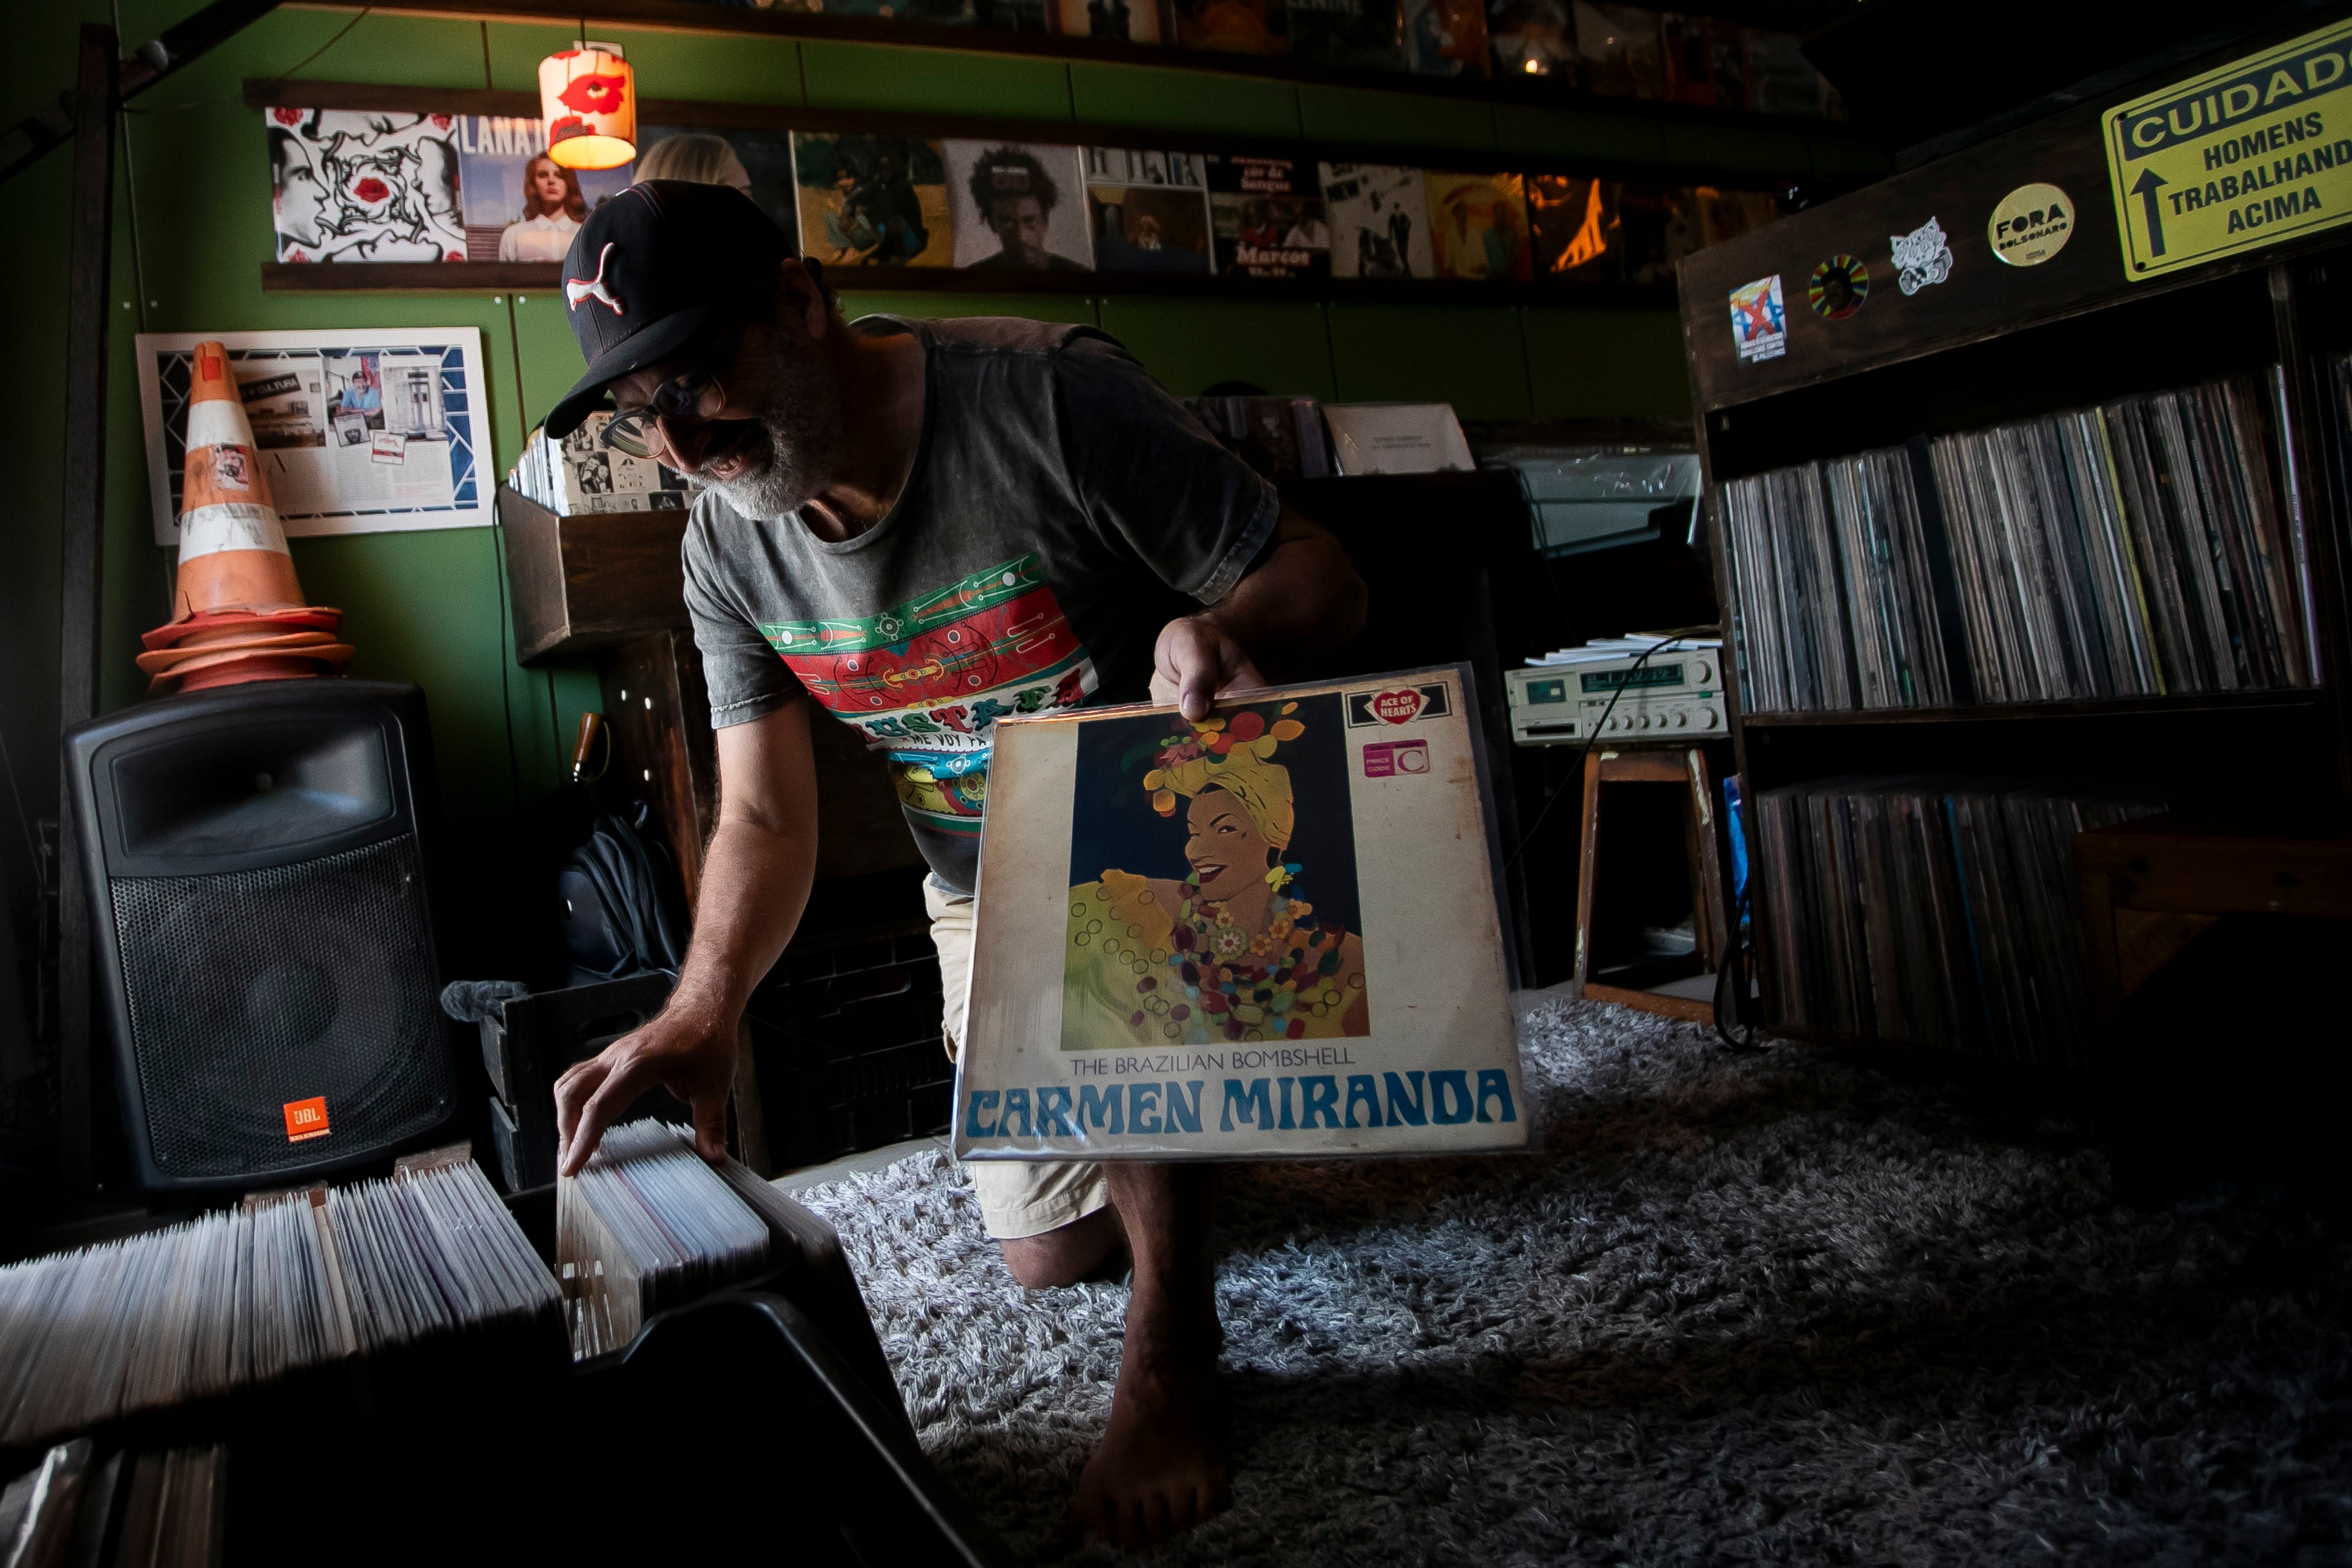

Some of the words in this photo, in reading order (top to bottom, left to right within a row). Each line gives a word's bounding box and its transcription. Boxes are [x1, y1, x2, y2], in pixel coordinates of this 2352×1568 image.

[2132, 47, 2352, 148] CUIDAD
[460, 114, 532, 155] LANA
[2203, 111, 2324, 171] HOMENS
[2168, 139, 2352, 216] TRABALHAND
[1996, 203, 2066, 240] FORA
[2227, 186, 2322, 235] ACIMA
[1380, 703, 1416, 717] HEARTS
[1381, 698, 1399, 707] ACE
[1400, 695, 1414, 705] OF
[908, 734, 932, 745] ME
[934, 734, 961, 746] VOY
[1397, 750, 1425, 773] C
[1070, 1058, 1108, 1076] THE
[1115, 1052, 1224, 1075] BRAZILIAN
[1232, 1047, 1355, 1069] BOMBSHELL
[293, 1107, 320, 1125] JBL
[965, 1080, 1205, 1138] CARMEN
[1220, 1069, 1517, 1132] MIRANDA
